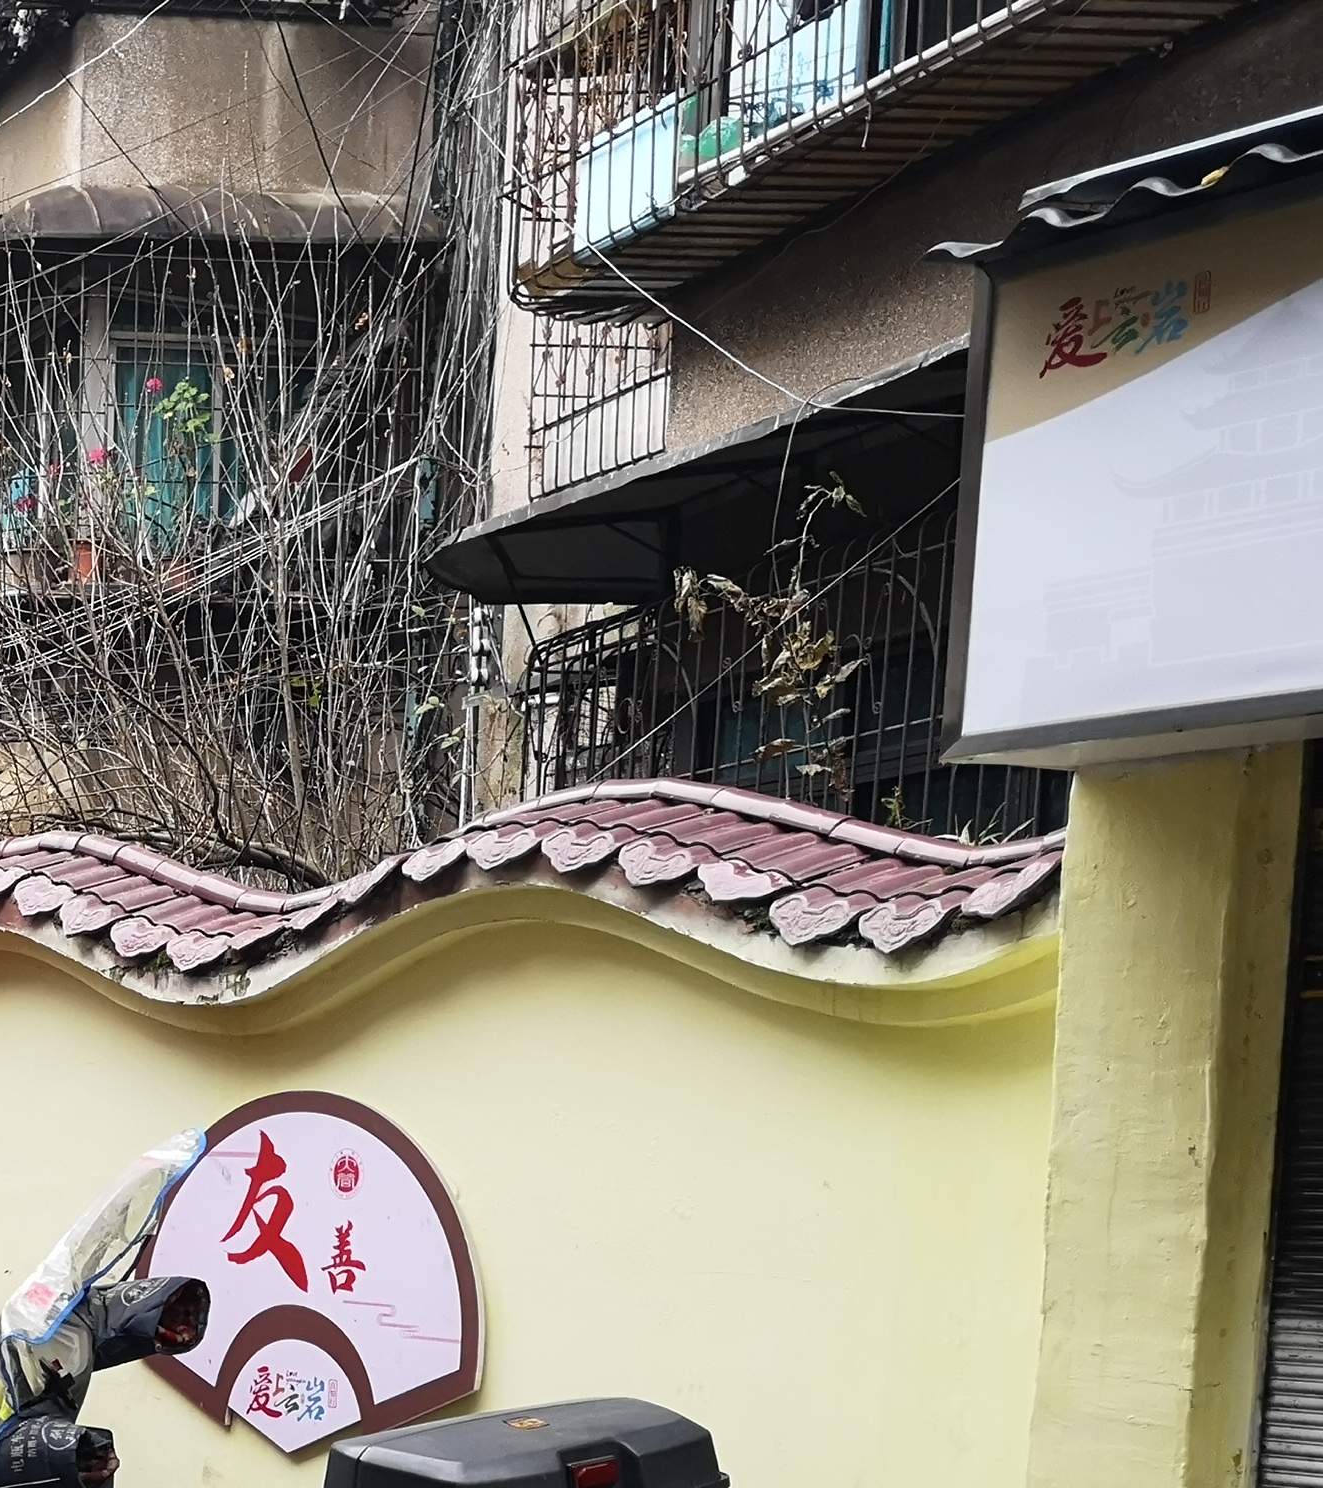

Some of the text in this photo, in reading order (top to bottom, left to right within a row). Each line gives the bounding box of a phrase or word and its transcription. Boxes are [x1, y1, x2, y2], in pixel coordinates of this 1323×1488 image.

[220, 1129, 367, 1295] 友善
[246, 1366, 325, 1422] 爱上云岩
